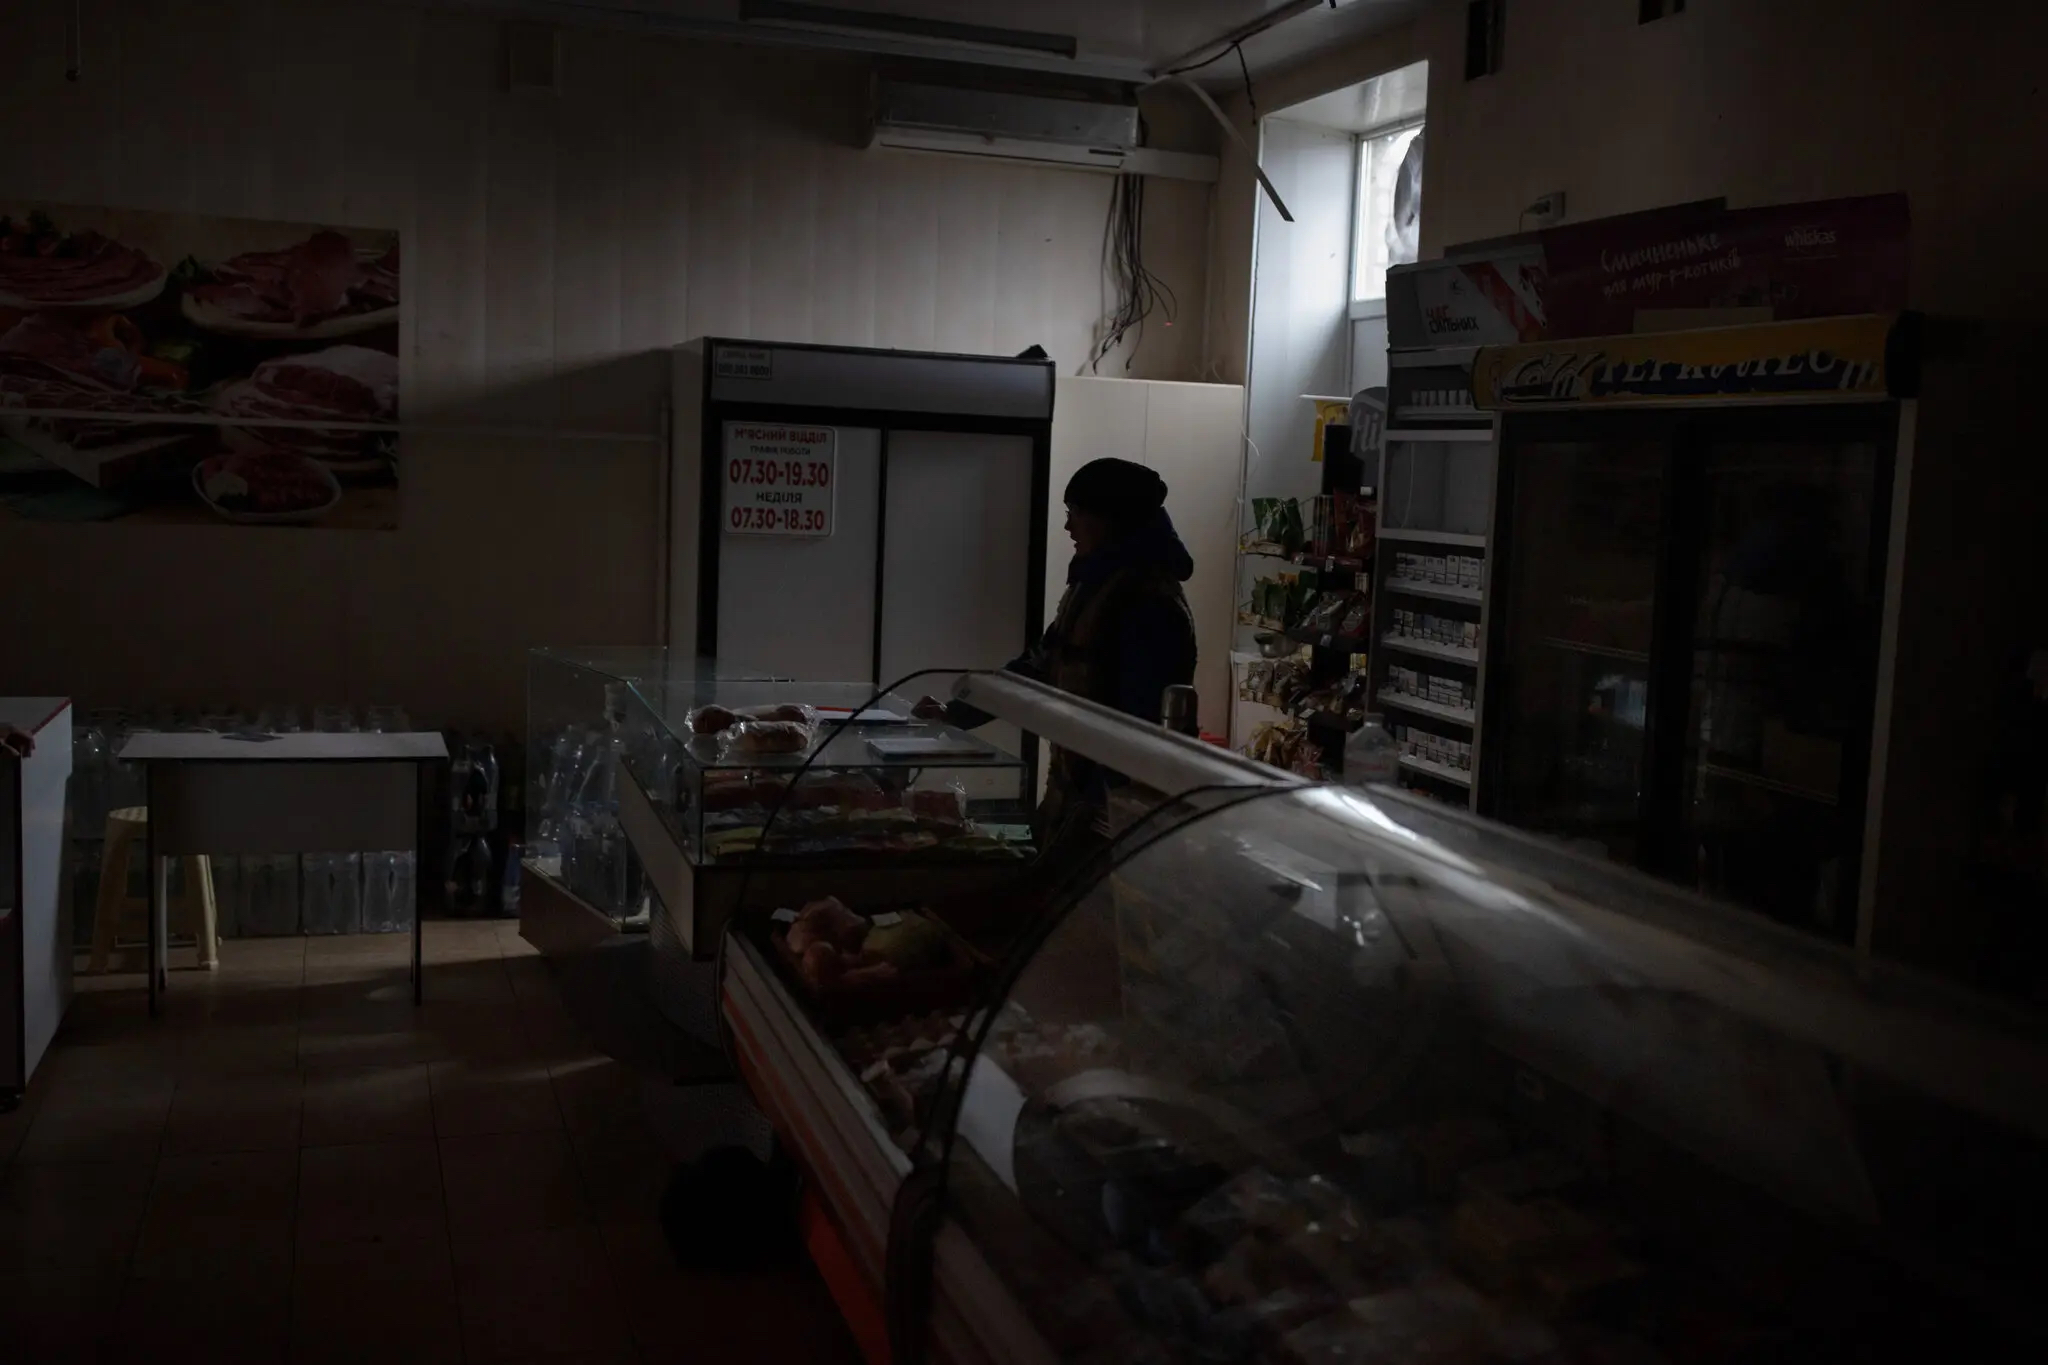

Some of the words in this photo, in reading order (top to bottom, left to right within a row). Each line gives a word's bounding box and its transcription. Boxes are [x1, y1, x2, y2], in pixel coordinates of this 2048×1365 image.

[1784, 229, 1837, 249] whiskas
[1429, 316, 1480, 334] СИЛЬНИХ
[734, 428, 786, 441] М'ЯСНИЙ
[789, 431, 827, 444] ВІДДІЛ
[750, 445, 778, 455] ГРАФІК
[780, 447, 811, 455] РОБОТИ
[729, 458, 829, 487] 07.30-19.30
[756, 491, 803, 505] НЕДІЛЯ
[731, 507, 824, 530] 07.30-18.30
